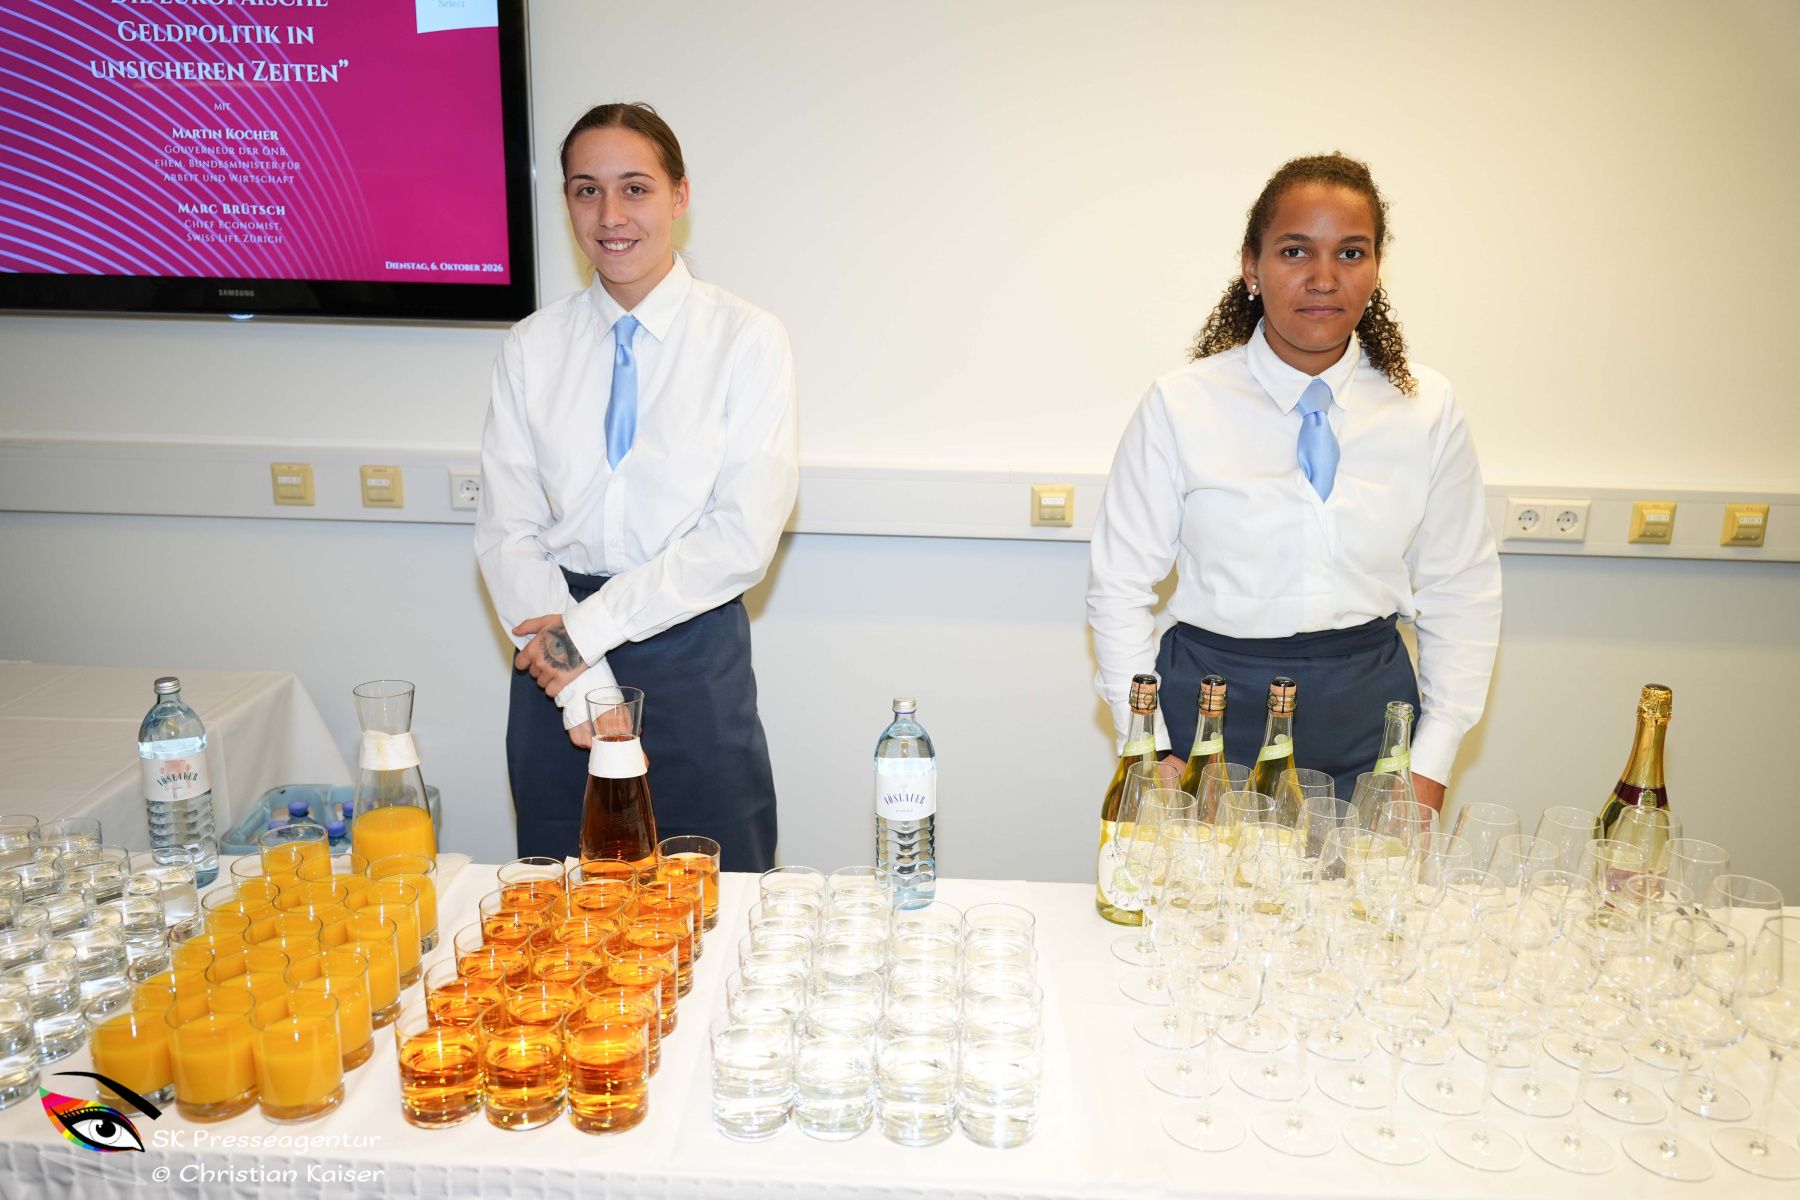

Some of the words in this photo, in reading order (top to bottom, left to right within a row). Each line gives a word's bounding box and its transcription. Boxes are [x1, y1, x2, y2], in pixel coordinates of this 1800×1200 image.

[438, 0, 465, 8] Select
[117, 20, 281, 45] GELDPOLITIK
[287, 26, 315, 45] IN
[90, 60, 245, 81] UNSICHEREN
[214, 102, 231, 111] MIT
[172, 128, 222, 139] MARTIN
[225, 128, 279, 141] KOCHER
[164, 145, 235, 155] GOUVERNEUR
[238, 146, 259, 156] DER
[154, 159, 186, 168] EHEM.
[189, 159, 278, 170] BUNDESMINISTER
[281, 160, 301, 170] FÜR
[163, 173, 199, 182] ARBEIT
[202, 174, 226, 183] UND
[229, 174, 295, 184] WIRTSCHAFT
[178, 203, 218, 214] MARC
[223, 203, 286, 216] BRÜTSCH
[184, 219, 215, 229] CHIEF
[186, 234, 215, 243] SWISS
[218, 234, 240, 243] LIFE
[242, 234, 283, 244] ZÜRICH
[440, 262, 481, 272] OKTOBER
[481, 263, 504, 273] 2026
[218, 289, 255, 298] SAMSUNG
